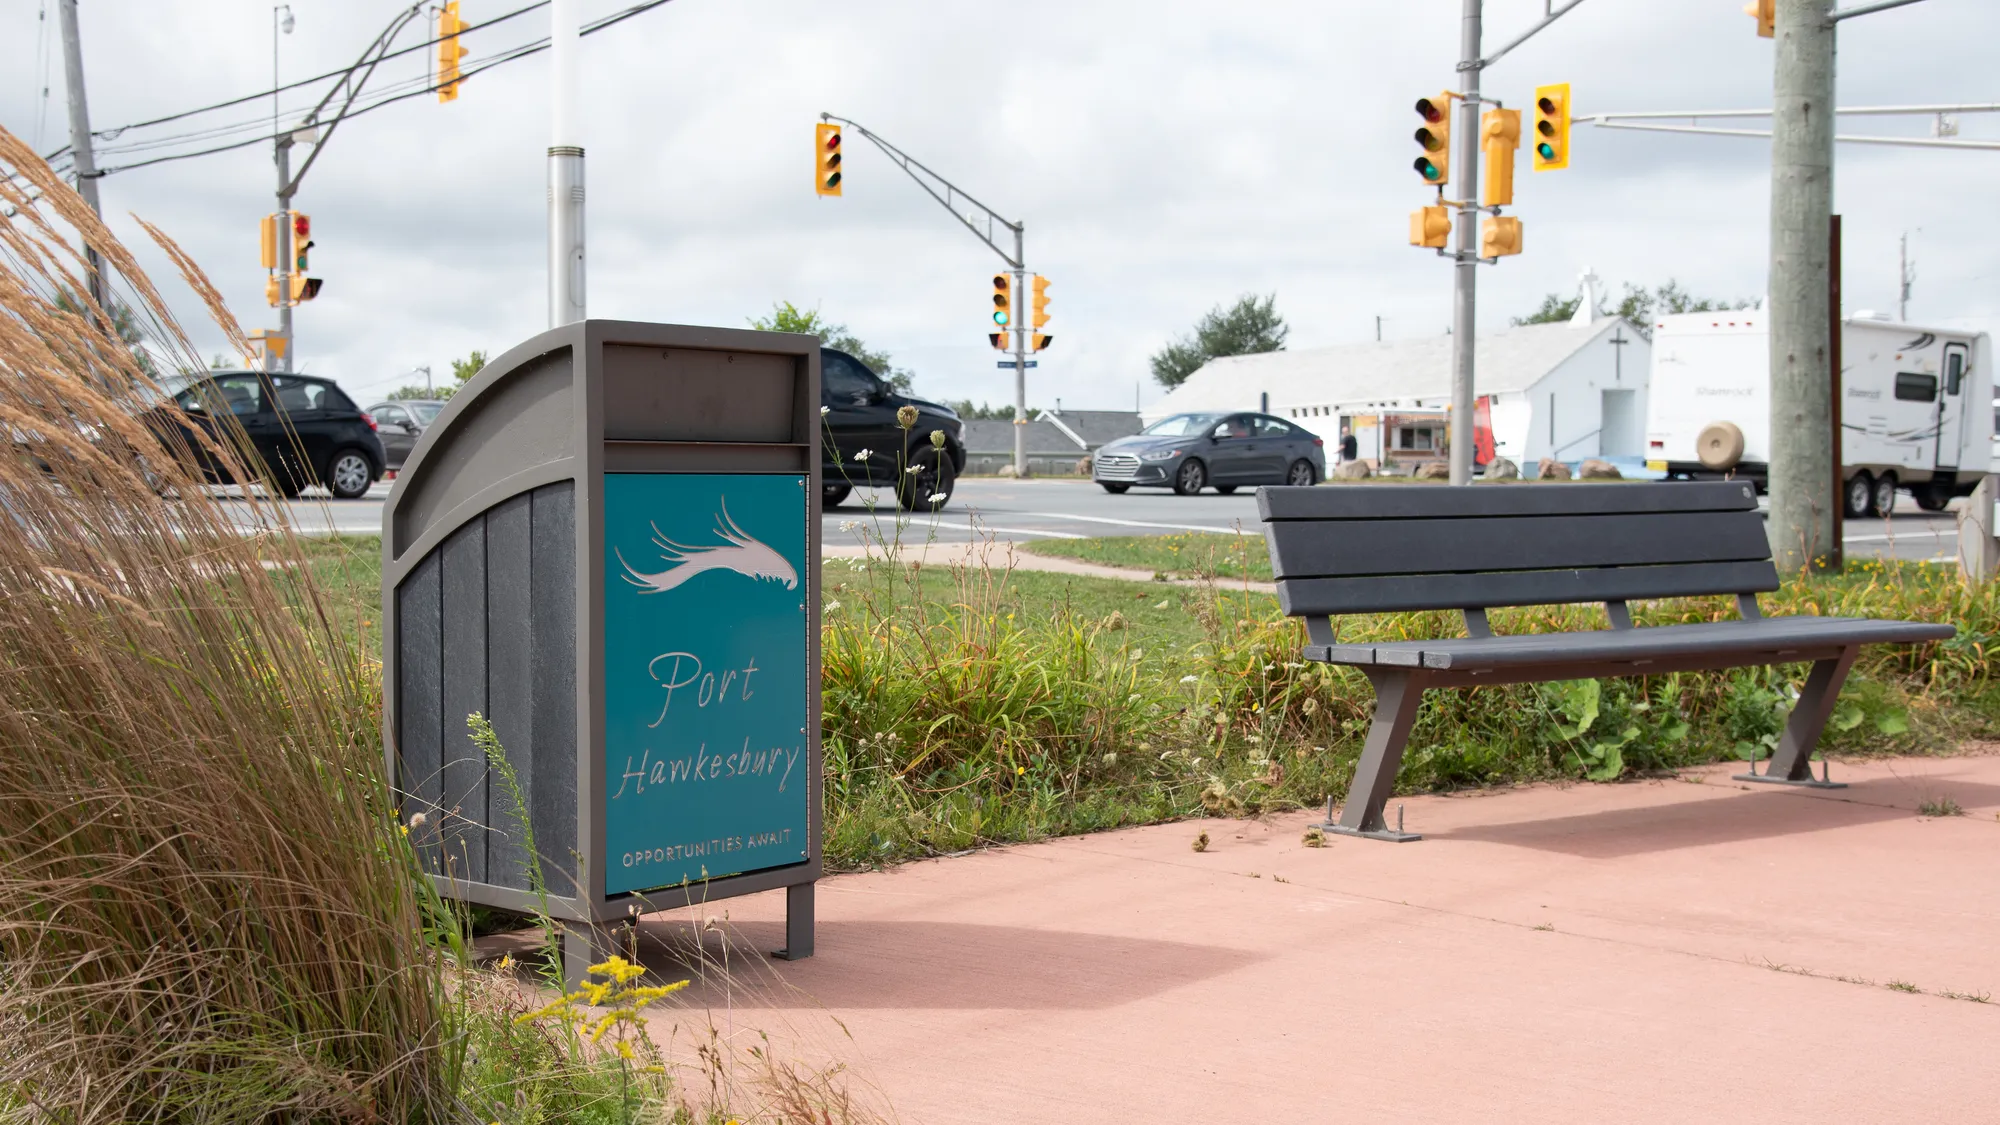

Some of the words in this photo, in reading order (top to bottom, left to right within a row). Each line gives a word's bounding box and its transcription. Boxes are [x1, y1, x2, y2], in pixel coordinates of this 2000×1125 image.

[647, 651, 760, 728] Port
[612, 736, 800, 799] Hawkesbury
[622, 835, 743, 868] OPPORTUNITIES
[747, 828, 792, 849] AWAIT
